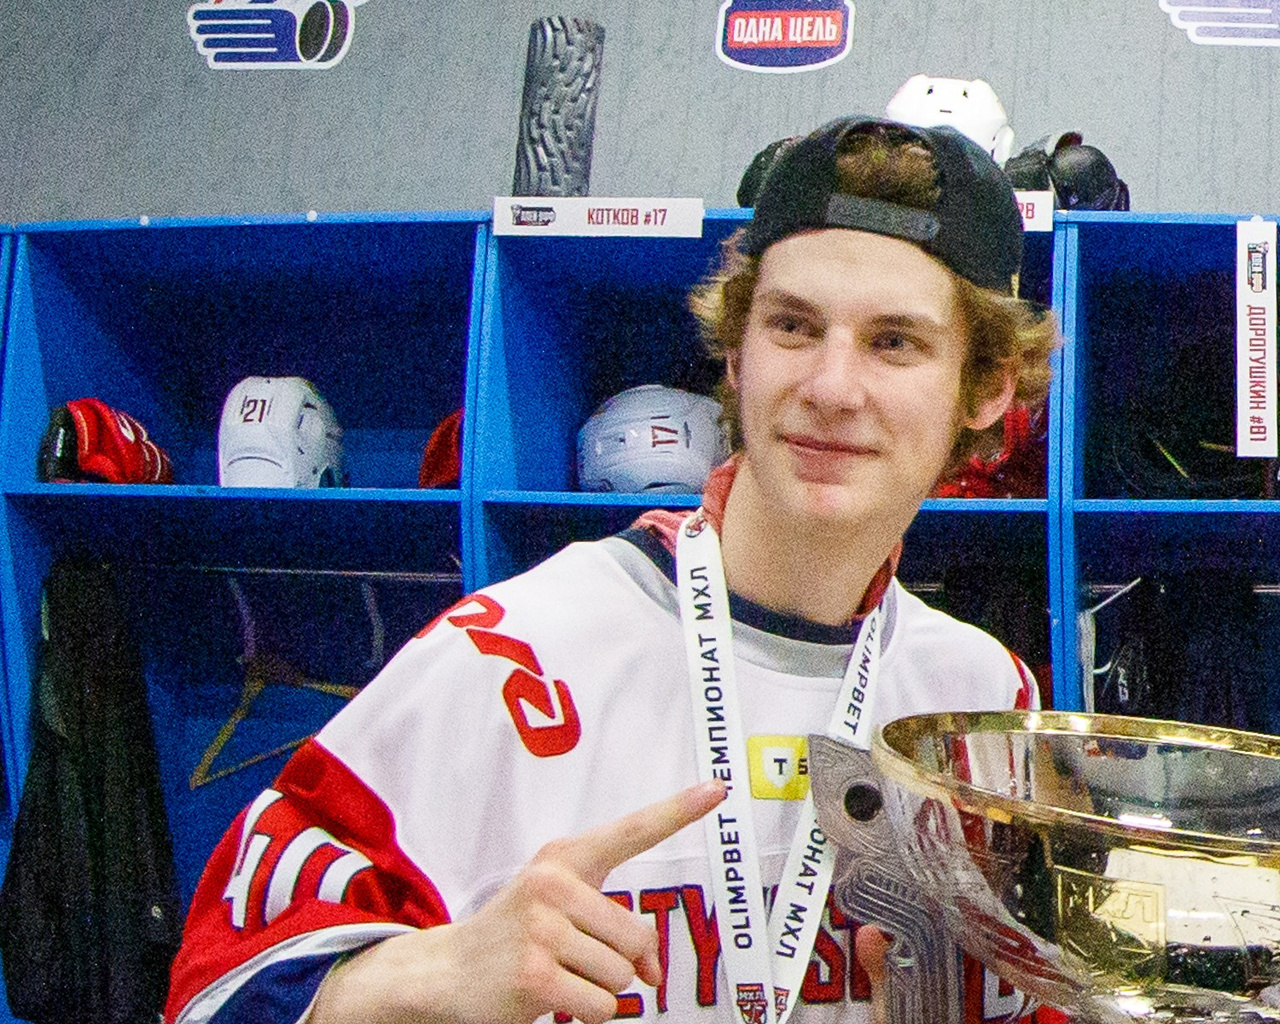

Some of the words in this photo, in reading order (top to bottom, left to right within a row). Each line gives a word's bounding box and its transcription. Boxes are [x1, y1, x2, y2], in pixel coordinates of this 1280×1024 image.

[733, 17, 783, 44] ОДНА
[788, 16, 838, 43] ЦЕЛЬ
[587, 207, 639, 226] КОТКОВ
[643, 208, 668, 226] #17
[1246, 304, 1267, 411] ДОРОГУШКИН
[242, 398, 268, 424] 21
[650, 424, 679, 448] 17
[1249, 414, 1268, 443] #81
[690, 566, 716, 622] МХЛ
[718, 813, 754, 950] OLIMPBET
[776, 902, 808, 959] МХЛ
